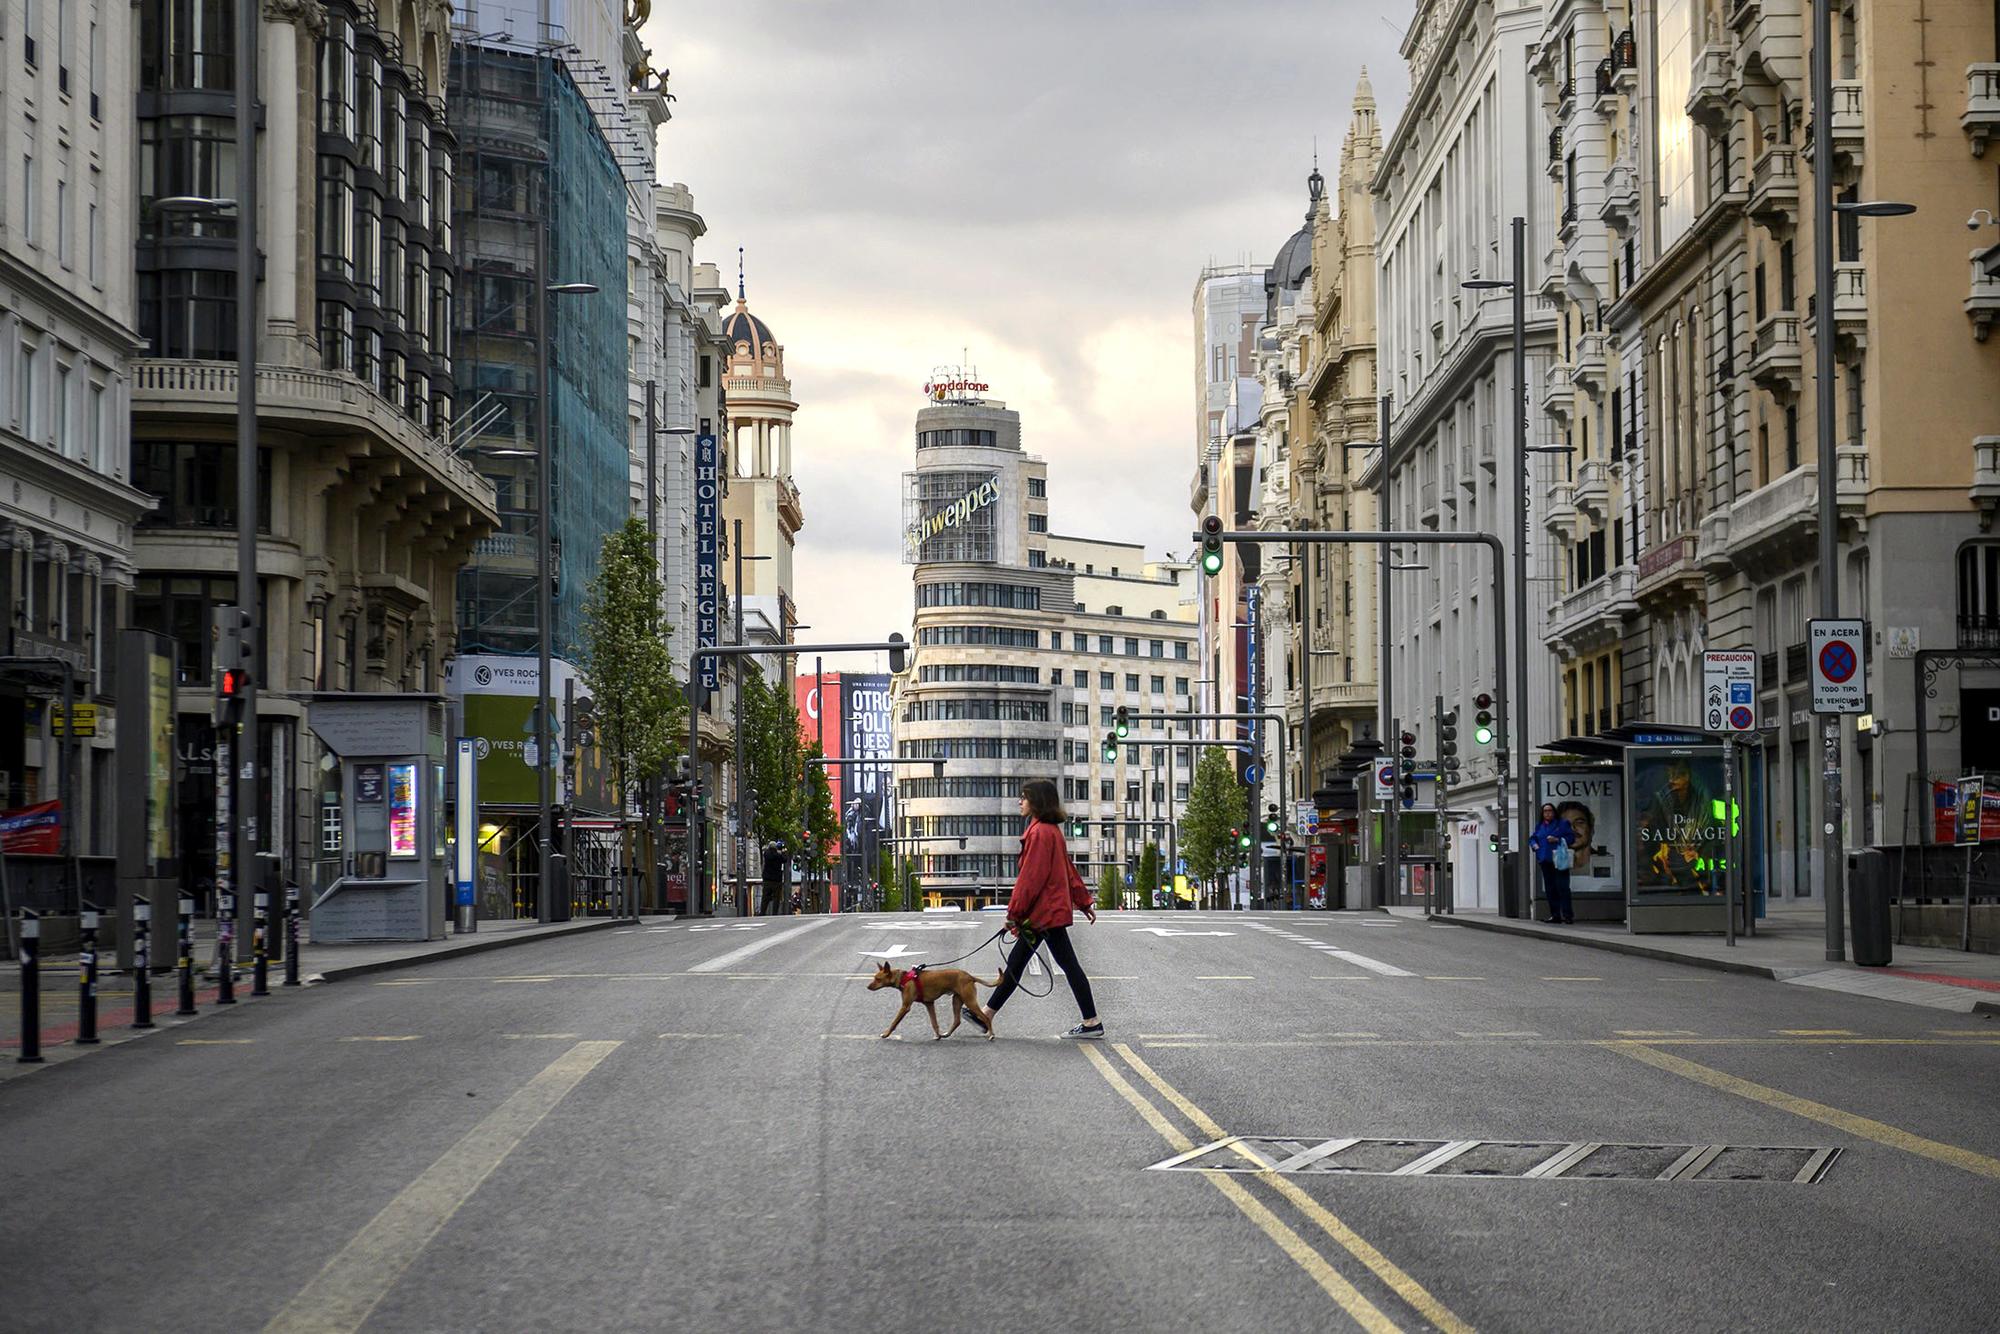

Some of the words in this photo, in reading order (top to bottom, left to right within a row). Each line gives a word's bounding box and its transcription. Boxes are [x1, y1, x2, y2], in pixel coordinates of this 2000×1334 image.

[933, 379, 989, 392] vodafone
[698, 466, 716, 554] HOTEL
[698, 563, 716, 688] REGENTE
[1814, 628, 1826, 637] EN
[1831, 628, 1860, 637] ACERA
[1706, 653, 1753, 662] PRECAUCIÓN
[493, 668, 515, 678] YVES
[1814, 697, 1823, 705] DE
[1711, 713, 1719, 725] 30
[491, 740, 514, 750] YVES
[1546, 780, 1614, 797] LOEWE
[1673, 814, 1696, 824] Dior
[1641, 826, 1726, 841] SAUVAGE
